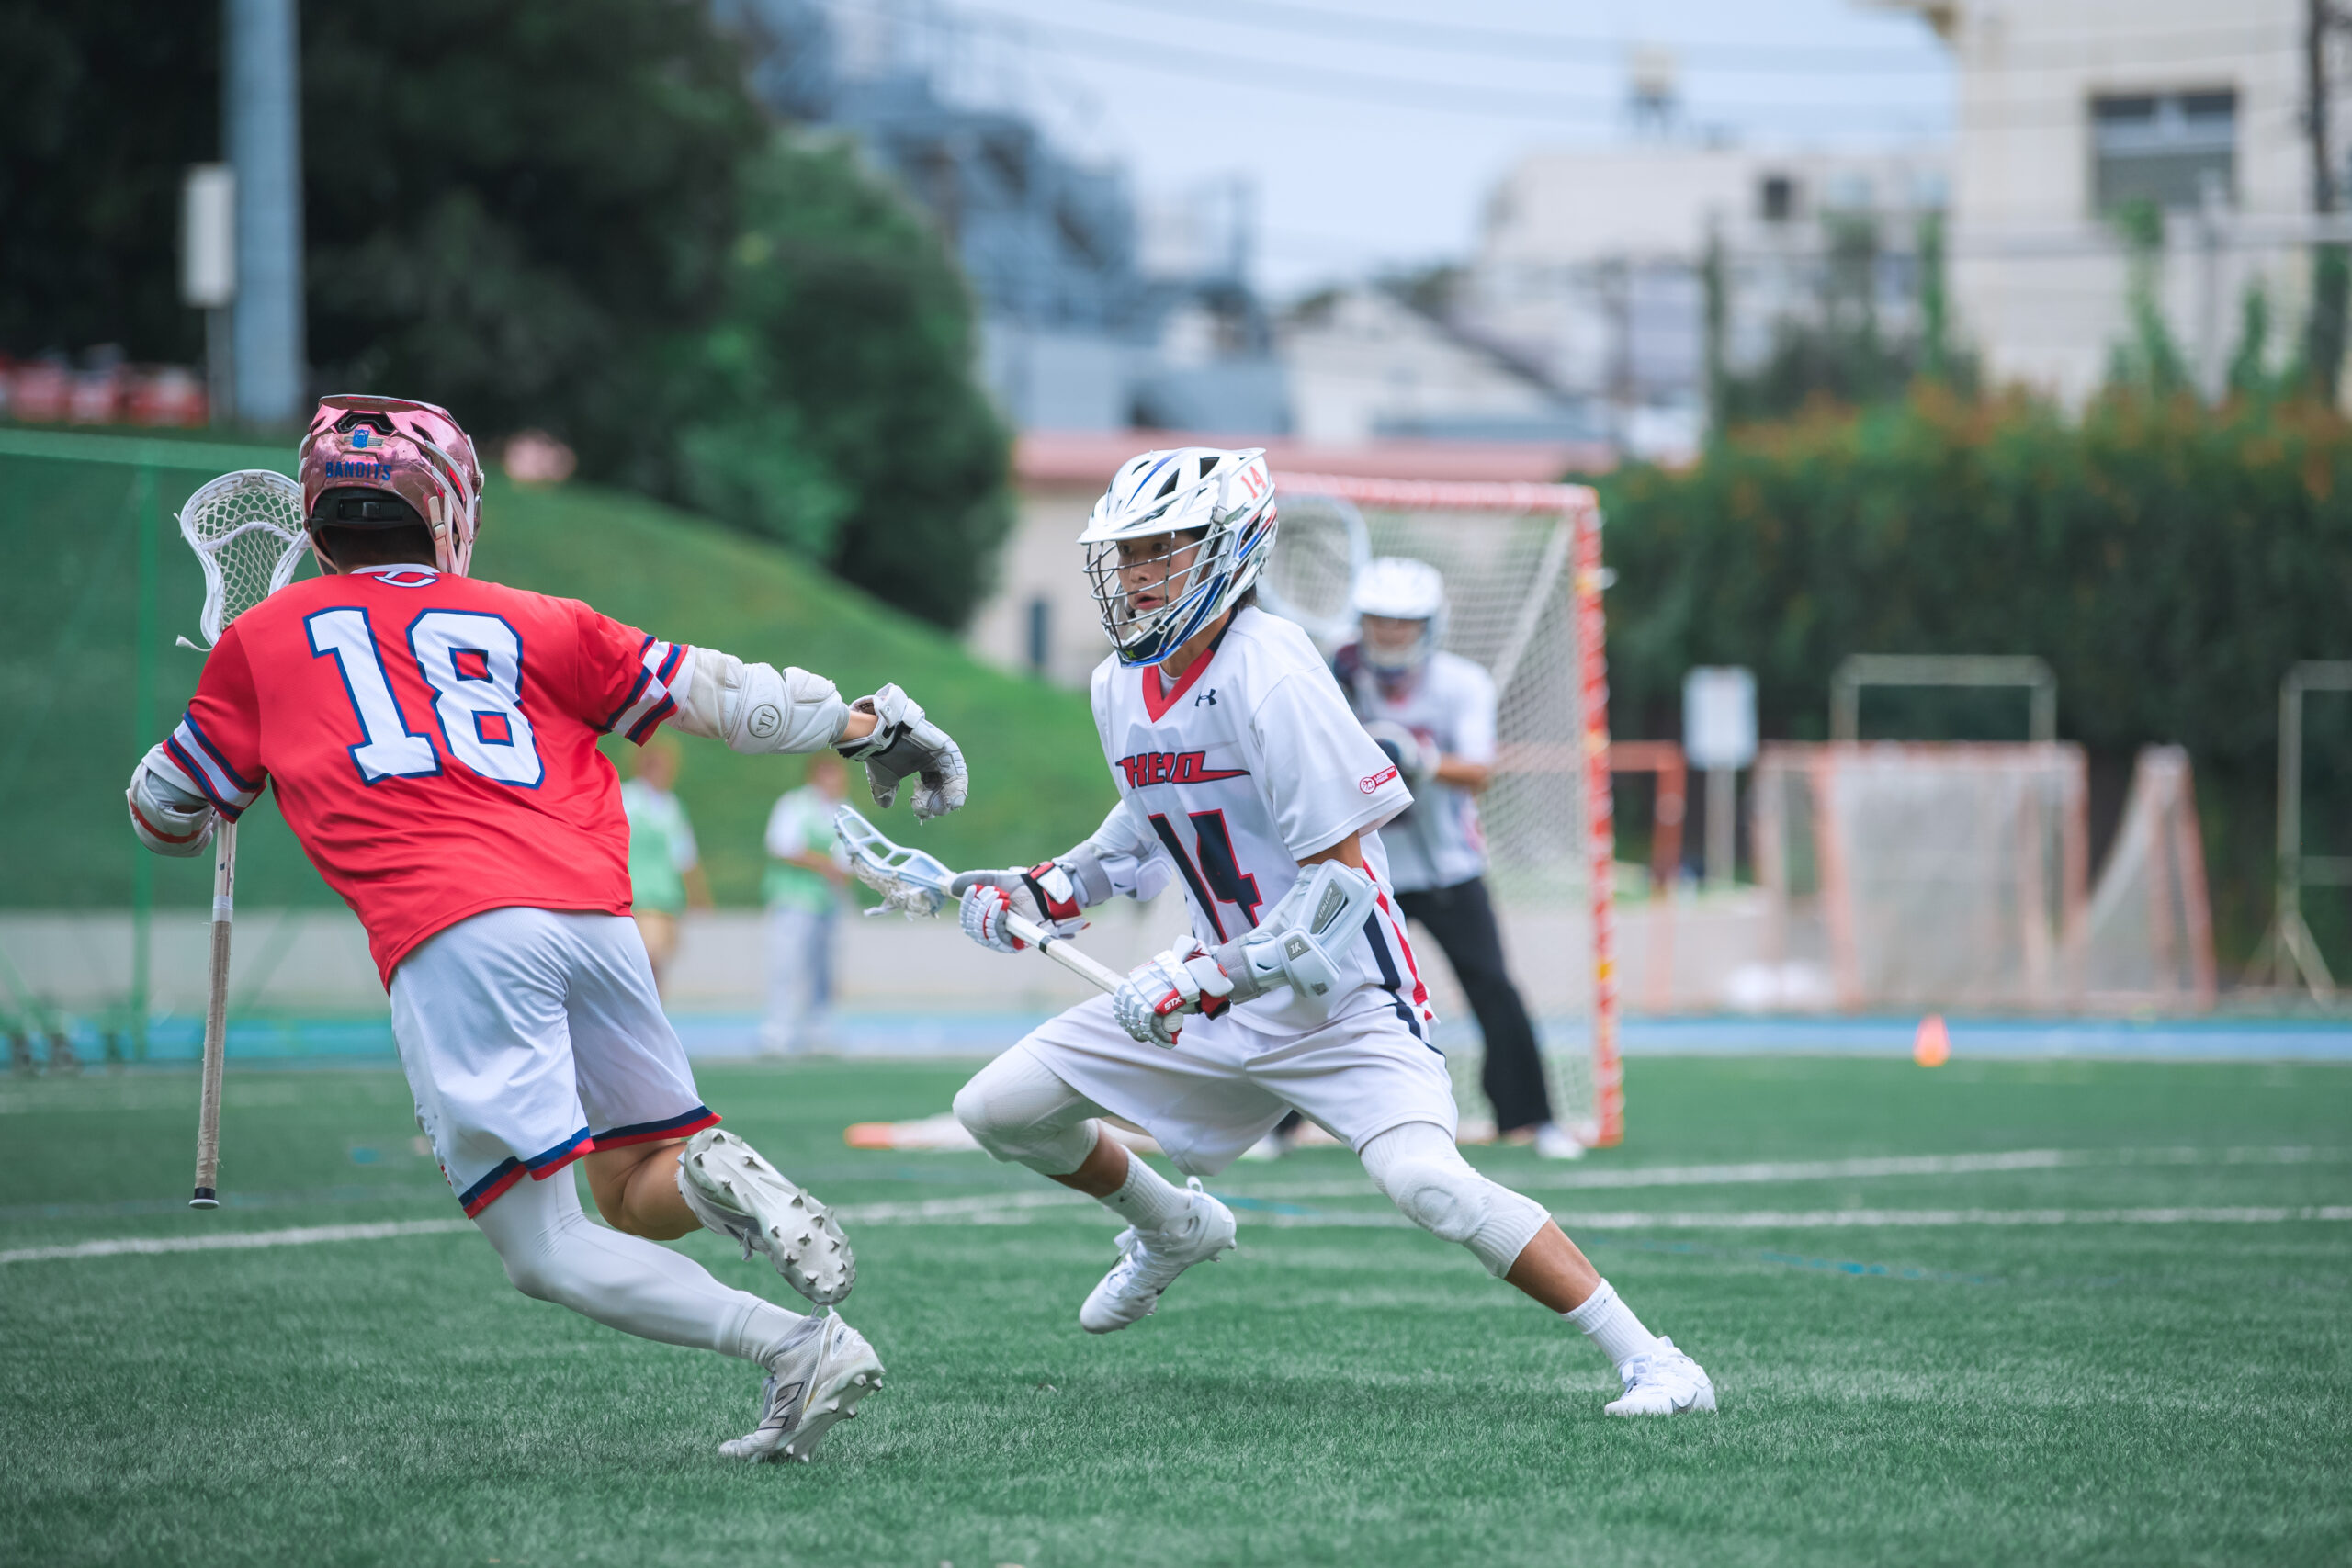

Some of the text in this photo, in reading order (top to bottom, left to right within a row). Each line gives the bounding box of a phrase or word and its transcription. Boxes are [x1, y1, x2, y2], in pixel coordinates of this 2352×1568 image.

[325, 461, 392, 481] BANDITS
[1240, 466, 1267, 500] 14
[302, 606, 546, 790] 18
[1148, 808, 1264, 945] 14
[1164, 996, 1182, 1011] STX
